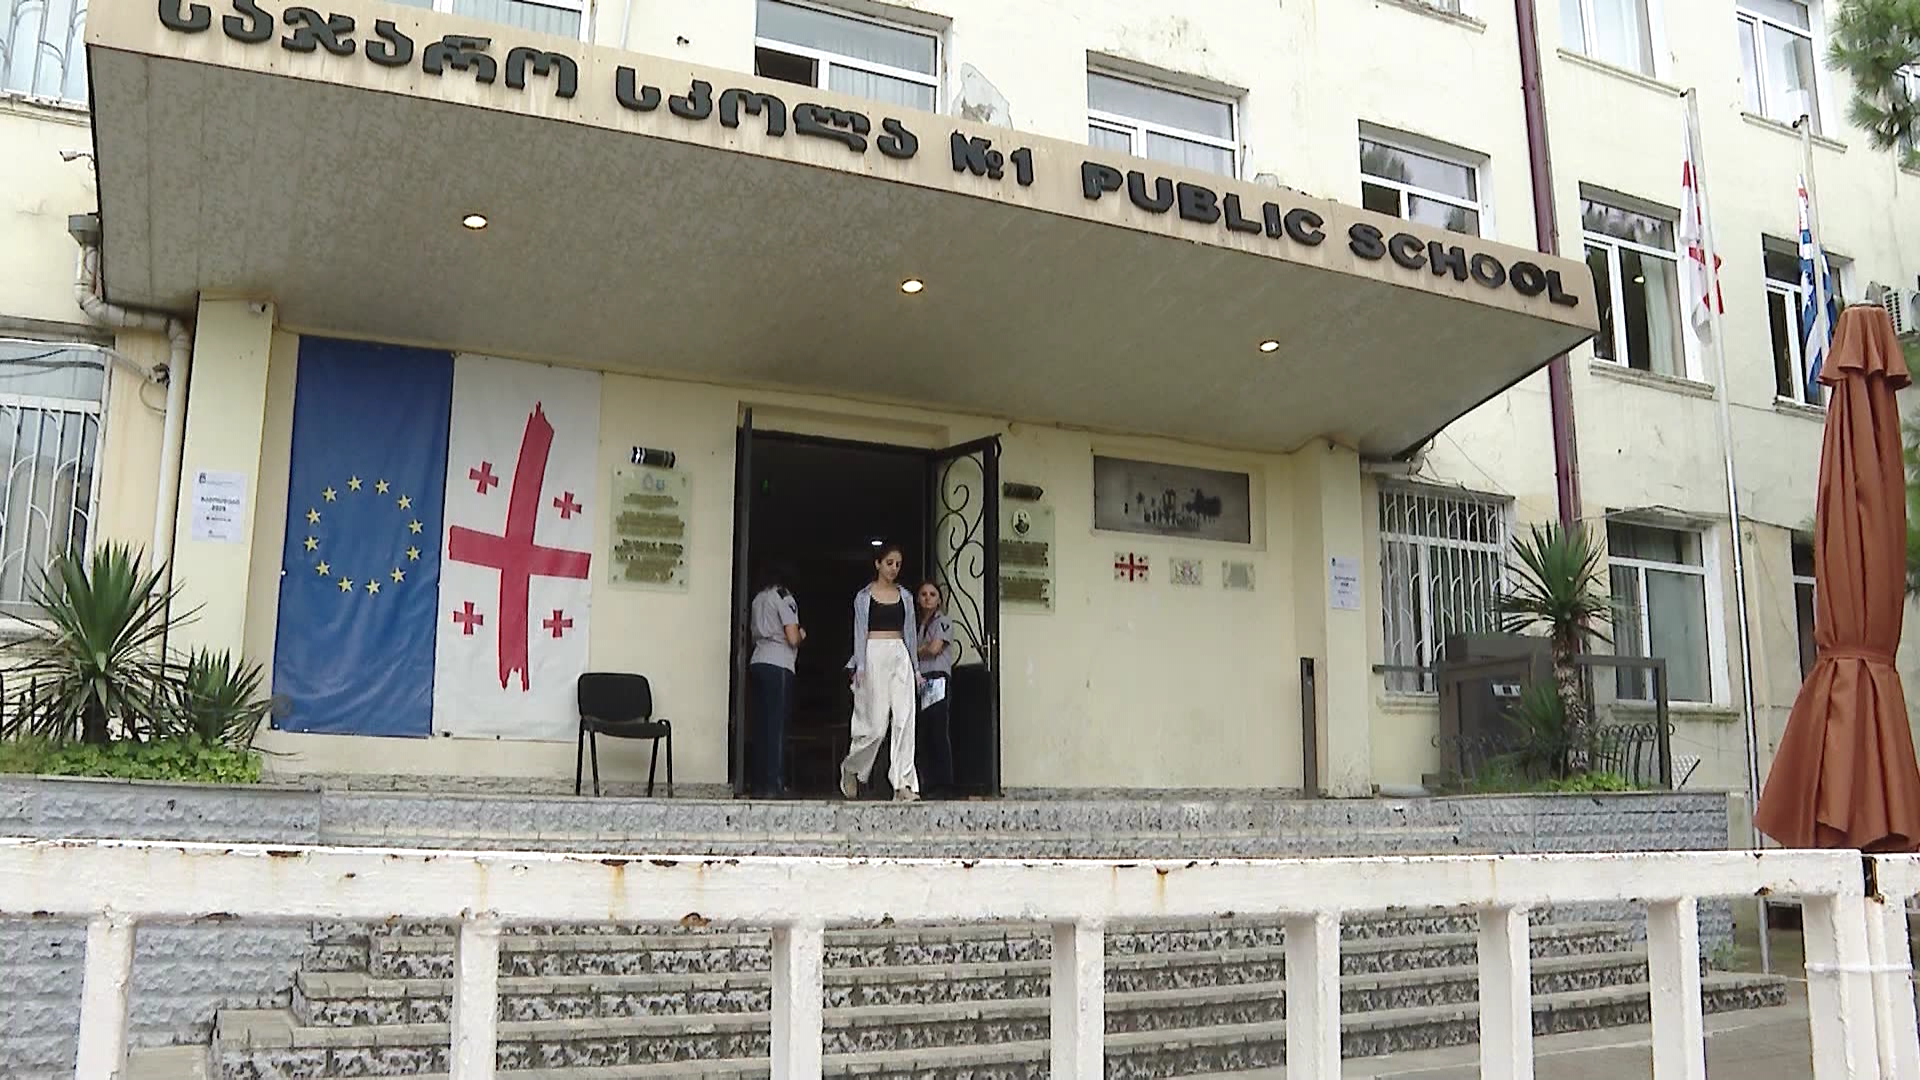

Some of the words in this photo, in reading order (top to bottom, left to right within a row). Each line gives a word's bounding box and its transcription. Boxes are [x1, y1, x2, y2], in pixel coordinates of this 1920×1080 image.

[158, 0, 578, 98] საჯარო
[615, 65, 919, 160] სკოლა
[1080, 160, 1326, 246] PUBLIC
[1348, 222, 1579, 308] SCHOOL
